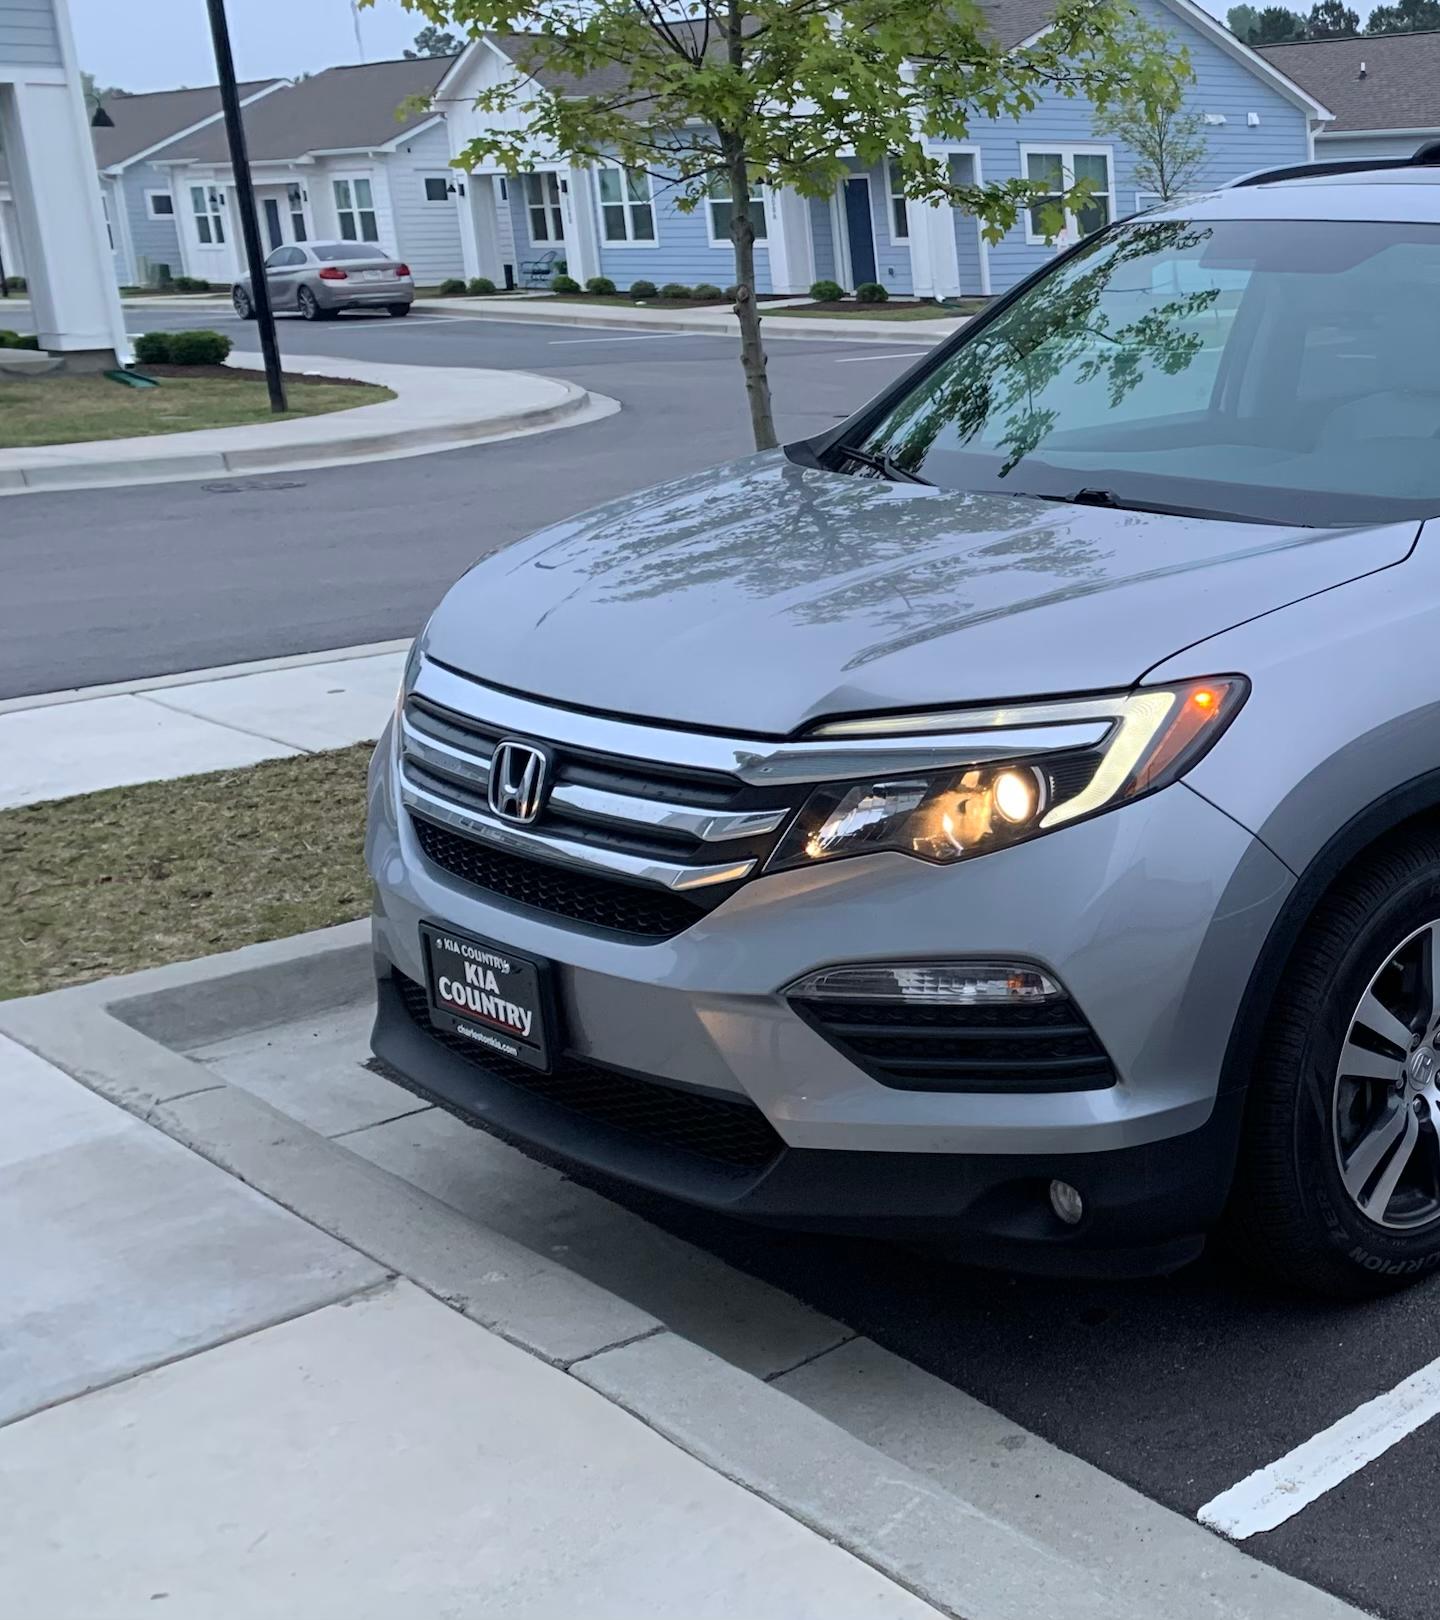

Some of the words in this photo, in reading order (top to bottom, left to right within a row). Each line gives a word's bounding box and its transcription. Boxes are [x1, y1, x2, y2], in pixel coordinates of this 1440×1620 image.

[443, 938, 460, 954] KIA
[461, 945, 508, 972] COUNTRY
[464, 961, 500, 995] KIA
[438, 976, 532, 1037] COUNTRY
